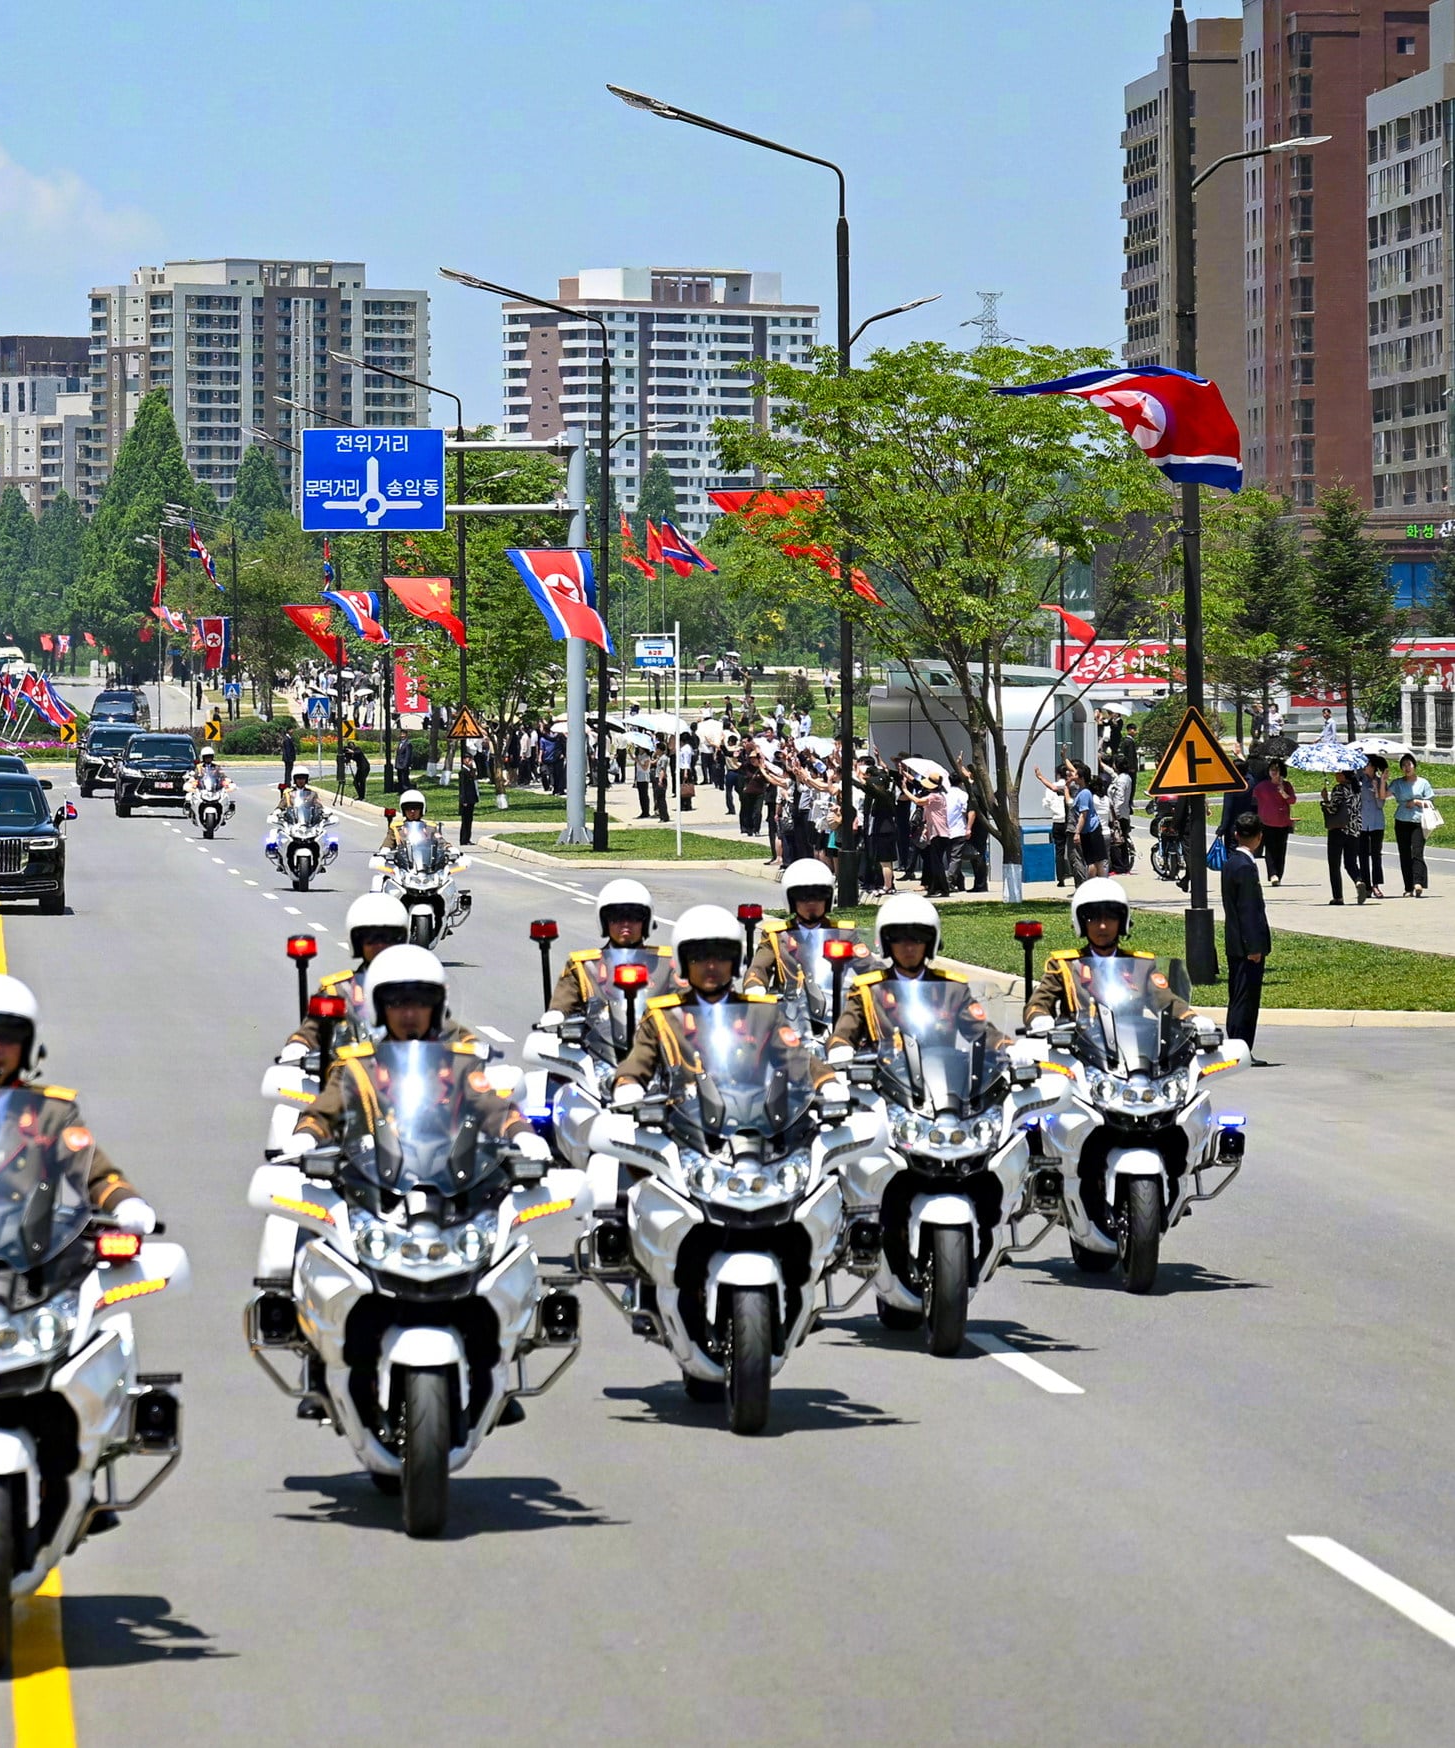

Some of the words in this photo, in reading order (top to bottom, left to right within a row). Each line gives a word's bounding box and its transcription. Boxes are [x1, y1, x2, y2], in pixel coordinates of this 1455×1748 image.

[336, 435, 409, 453] 전위거리
[305, 479, 360, 497] 문덕거리
[386, 479, 440, 497] 송암동
[1406, 524, 1434, 539] 화성
